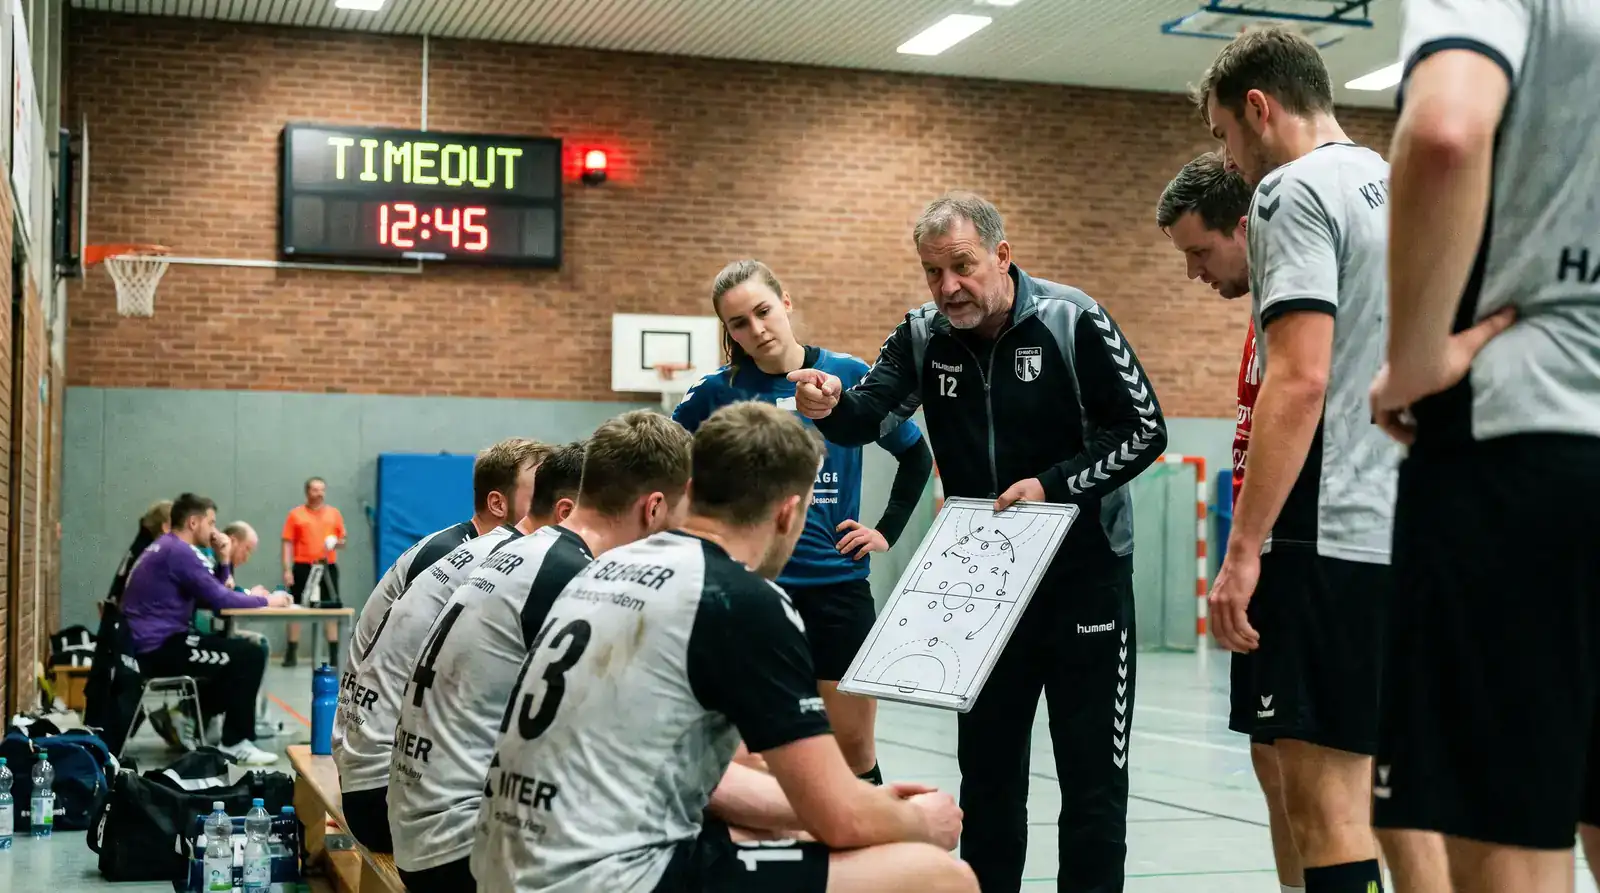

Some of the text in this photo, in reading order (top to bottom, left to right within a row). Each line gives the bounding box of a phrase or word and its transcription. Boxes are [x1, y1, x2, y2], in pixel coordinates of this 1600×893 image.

[328, 137, 523, 189] TIMEOUT
[379, 203, 488, 251] 12:45
[931, 360, 963, 373] hummel
[938, 373, 958, 398] 12
[1076, 619, 1115, 634] hummel
[500, 617, 591, 740] 13
